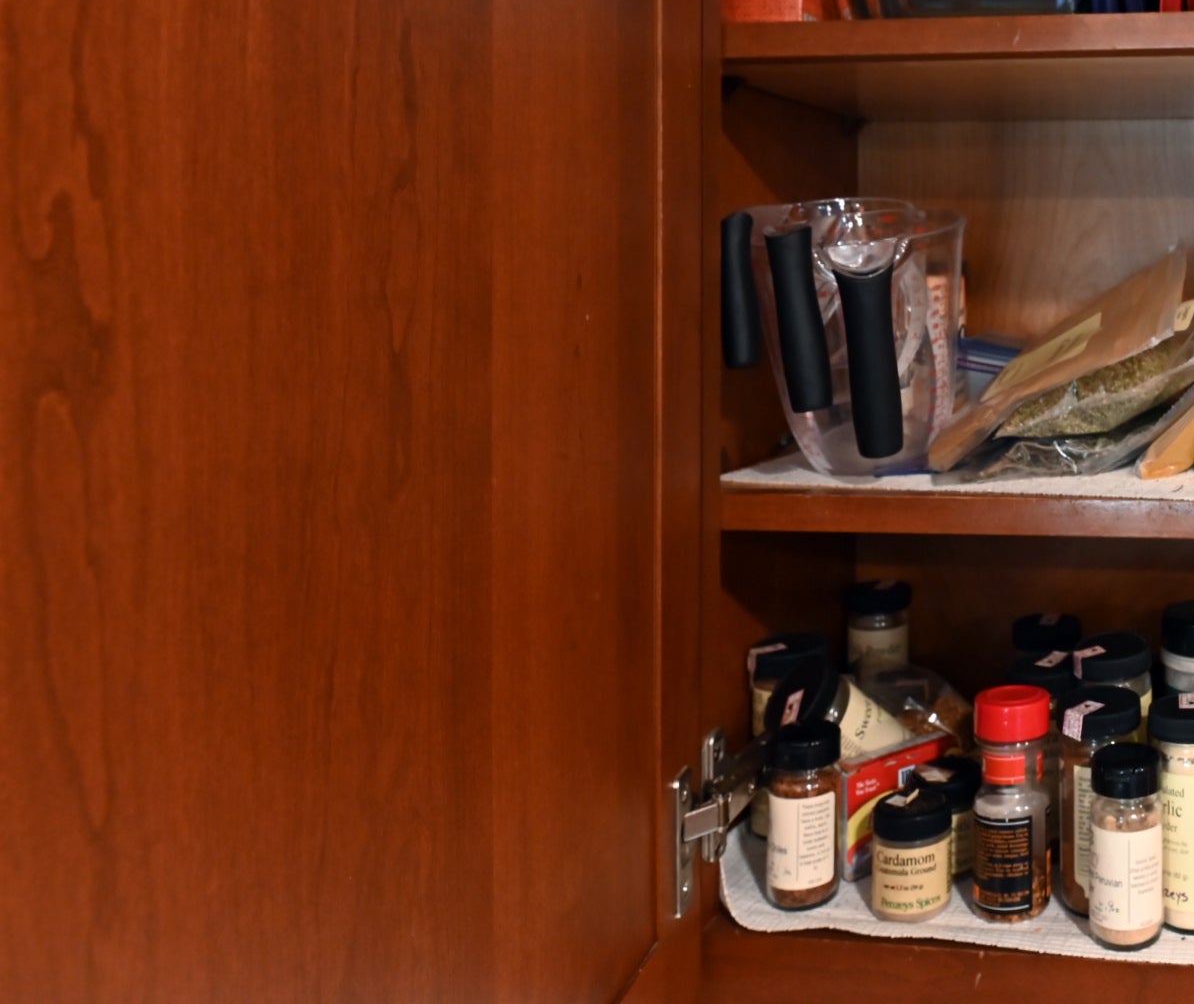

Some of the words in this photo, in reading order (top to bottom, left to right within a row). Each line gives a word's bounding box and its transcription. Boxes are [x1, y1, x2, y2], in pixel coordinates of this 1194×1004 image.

[876, 850, 935, 867] Cardamom
[910, 863, 937, 876] Ground
[880, 896, 914, 912] Penzeys
[916, 894, 941, 910] Spices
